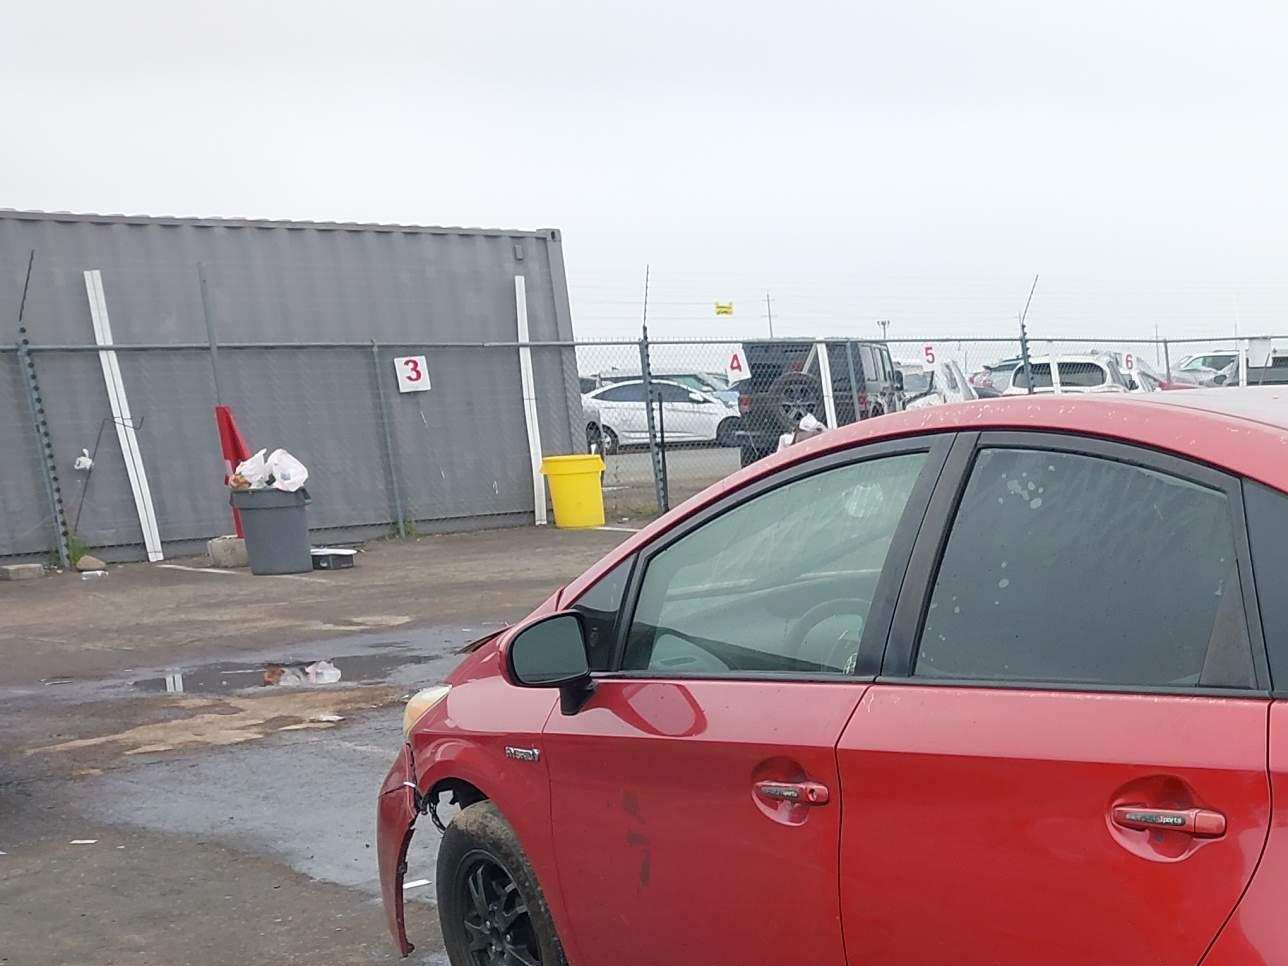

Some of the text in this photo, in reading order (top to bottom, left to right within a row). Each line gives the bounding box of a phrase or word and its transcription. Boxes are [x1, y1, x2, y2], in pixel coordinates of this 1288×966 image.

[730, 353, 743, 373] 4
[924, 346, 936, 364] 5
[1125, 353, 1134, 370] 6
[403, 359, 422, 382] 3
